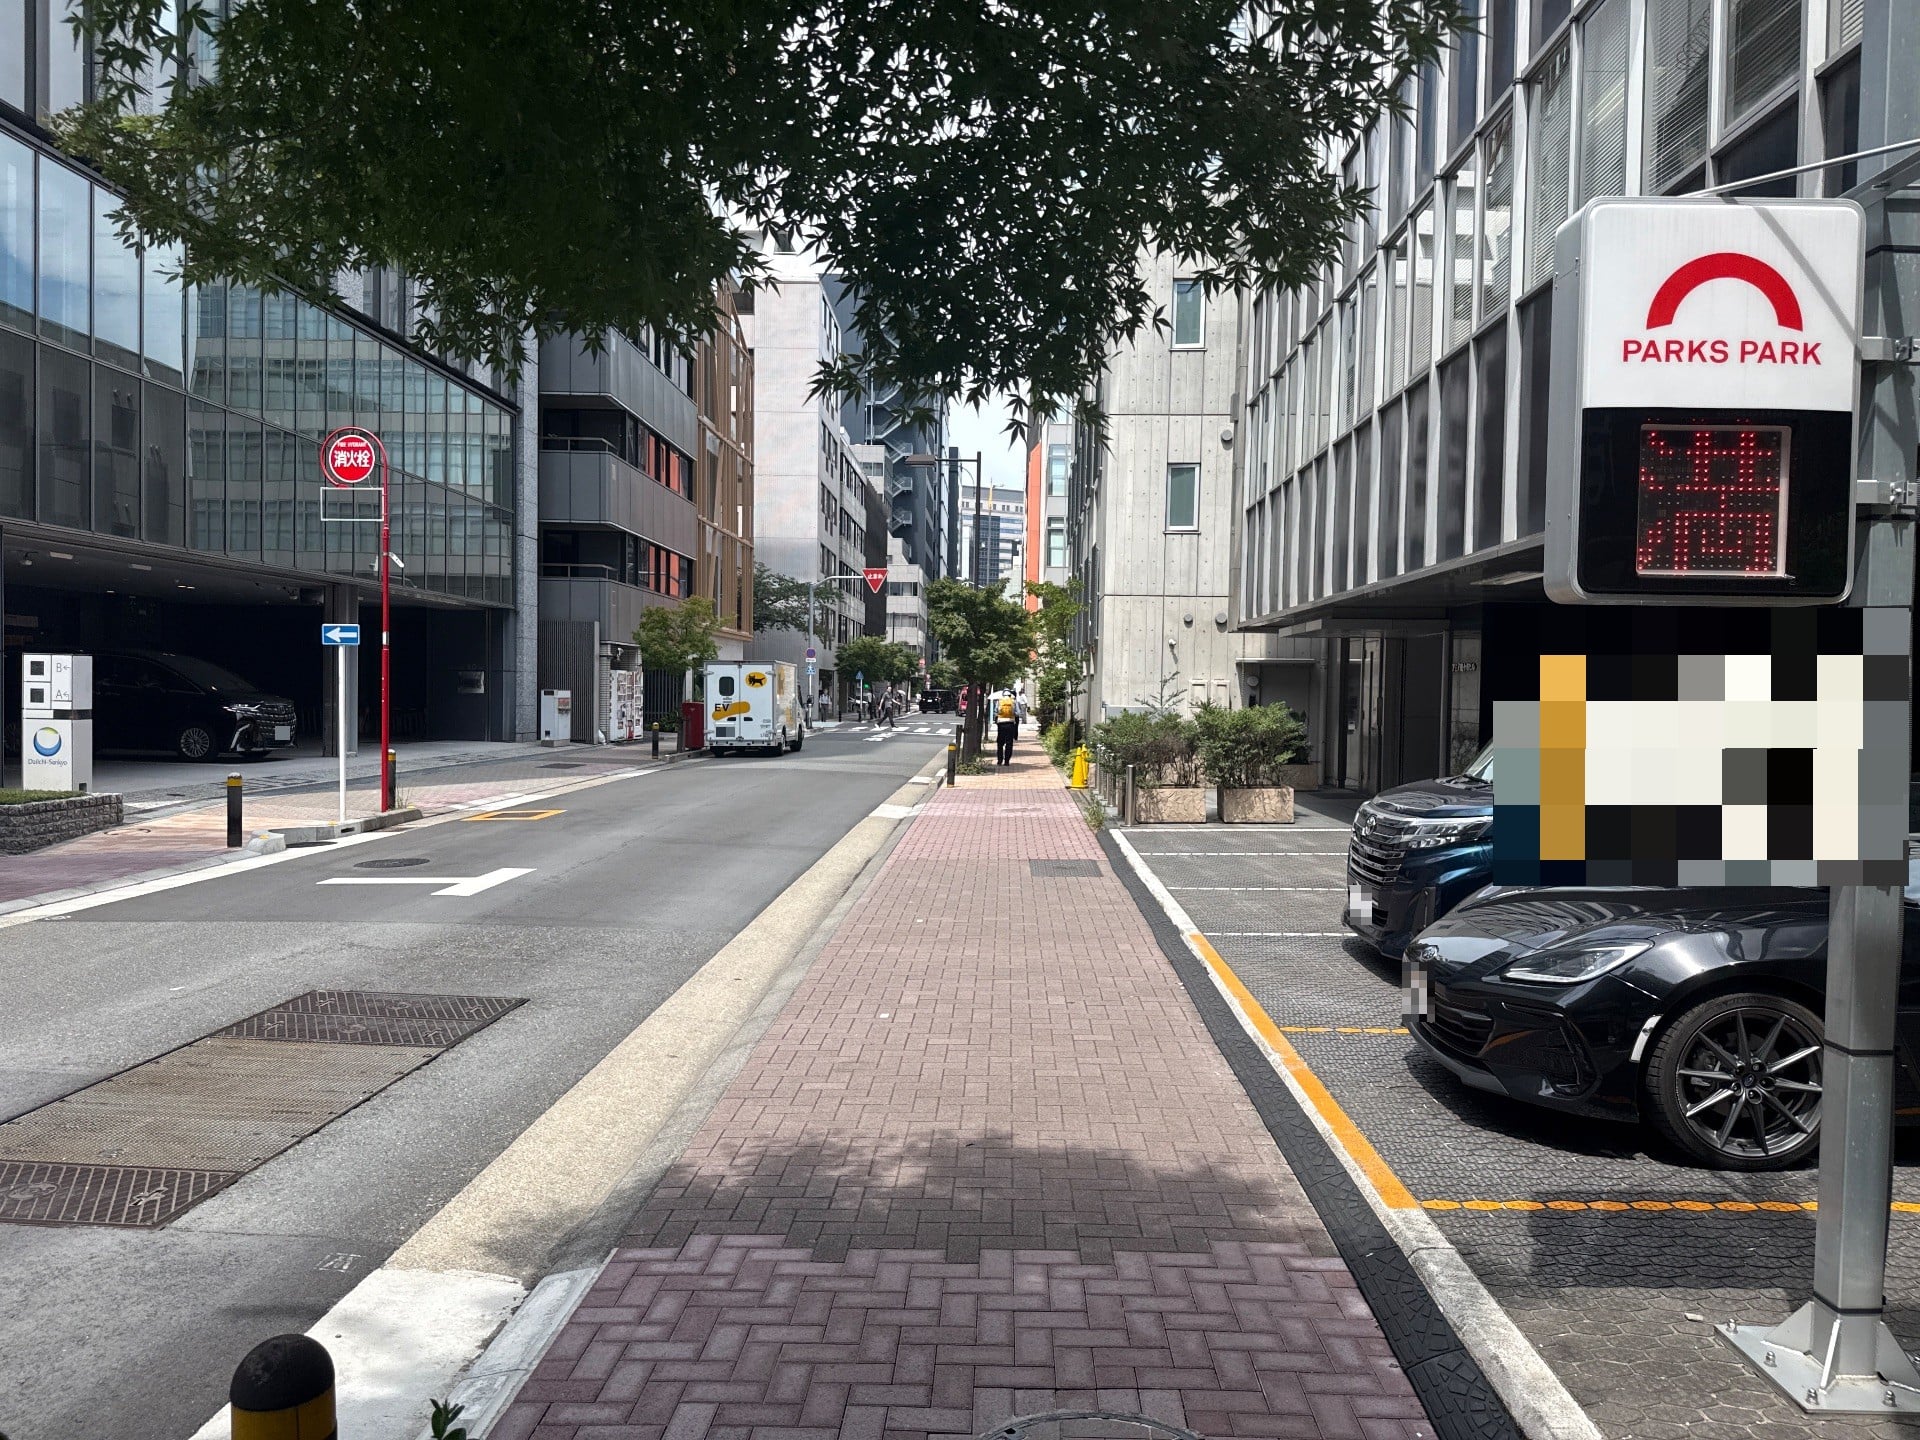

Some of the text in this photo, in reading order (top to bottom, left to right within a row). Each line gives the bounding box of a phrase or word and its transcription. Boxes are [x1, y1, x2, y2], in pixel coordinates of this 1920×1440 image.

[1622, 339, 1822, 365] PARKS PARK
[334, 450, 370, 467] 消火栓
[1637, 430, 1781, 572] 満
[56, 663, 62, 672] B
[56, 690, 62, 699] A
[715, 703, 730, 712] EV
